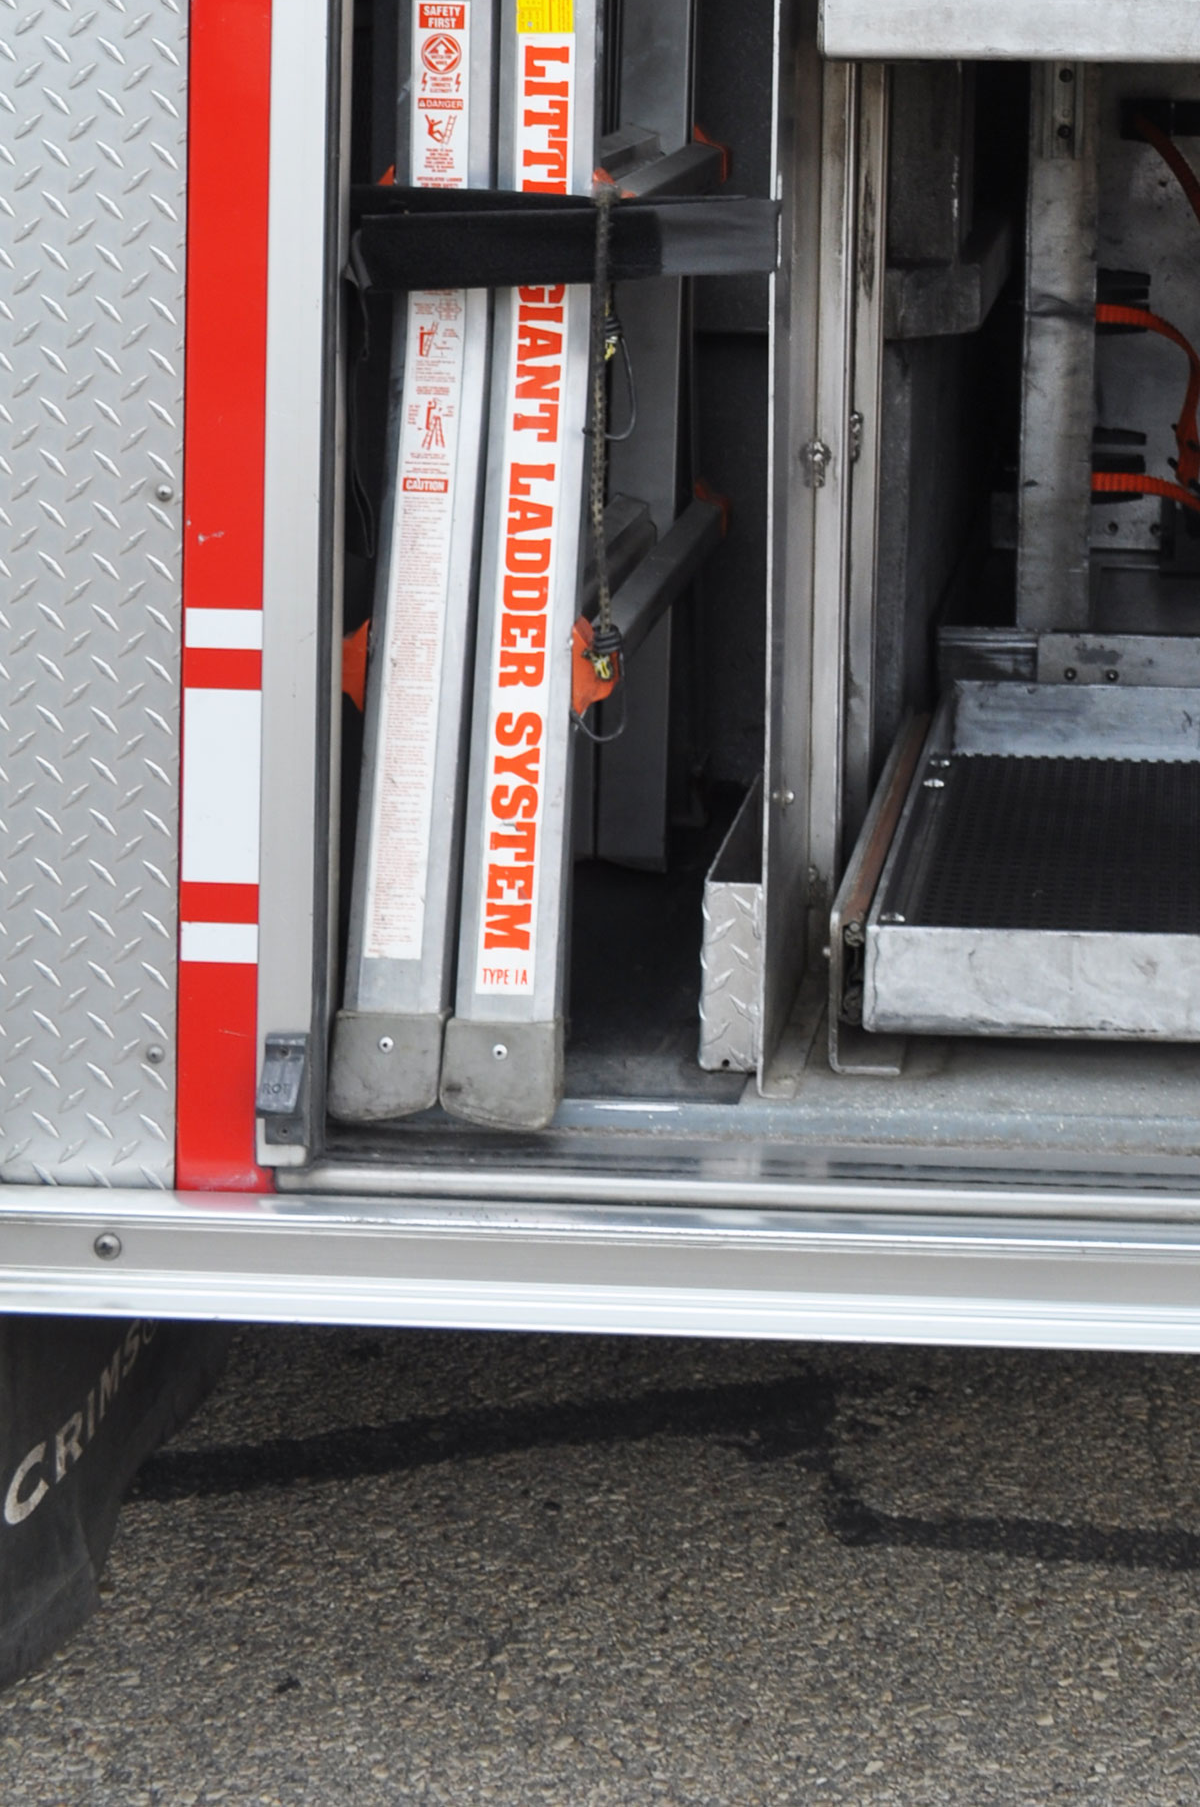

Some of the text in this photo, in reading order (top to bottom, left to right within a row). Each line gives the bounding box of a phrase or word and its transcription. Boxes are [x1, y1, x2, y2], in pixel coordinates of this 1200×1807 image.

[423, 5, 461, 17] SAFETY
[427, 17, 457, 28] FIRST
[426, 99, 463, 108] DANGER
[522, 45, 570, 194] LITT
[405, 479, 445, 492] CAUTION
[498, 462, 556, 688] LADDER
[483, 711, 543, 951] SYSTEM
[482, 968, 510, 985] TYPE
